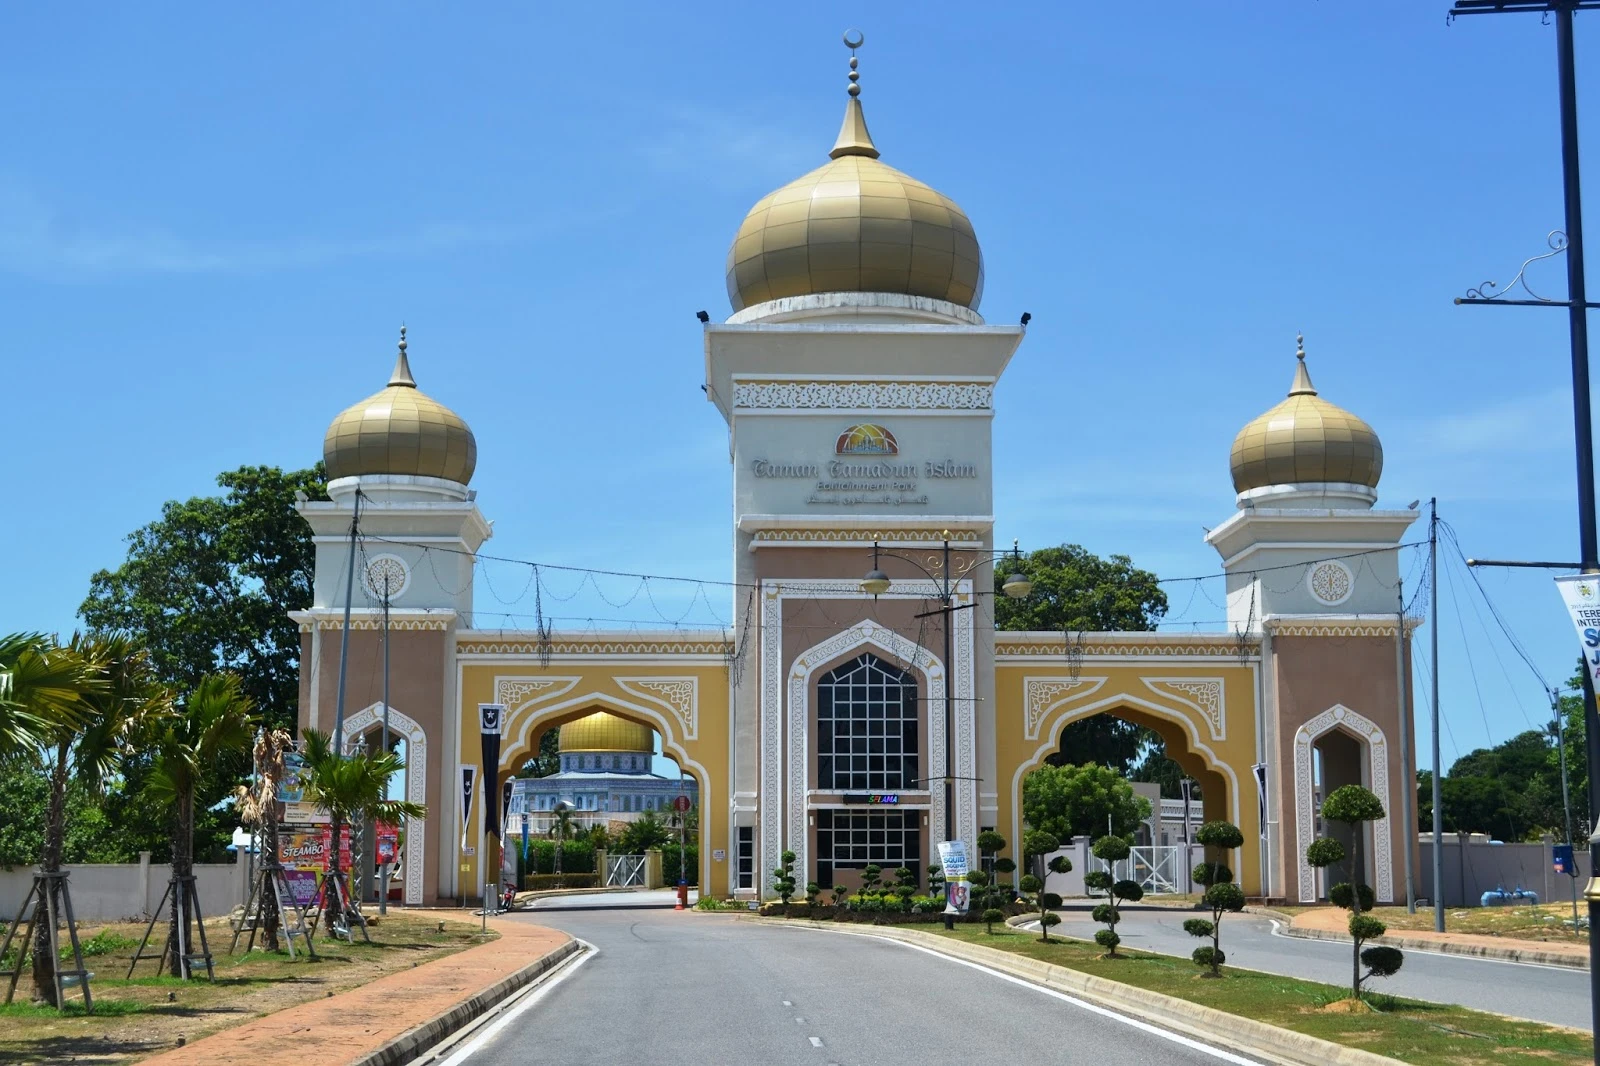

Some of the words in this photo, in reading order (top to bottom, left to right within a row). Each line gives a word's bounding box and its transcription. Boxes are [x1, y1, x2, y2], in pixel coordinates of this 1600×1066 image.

[752, 459, 818, 478] Taman
[830, 459, 918, 478] Tamadun
[924, 458, 977, 479] Islam
[892, 481, 918, 492] Park
[282, 844, 324, 858] STEAMBO
[943, 856, 966, 864] SQUID
